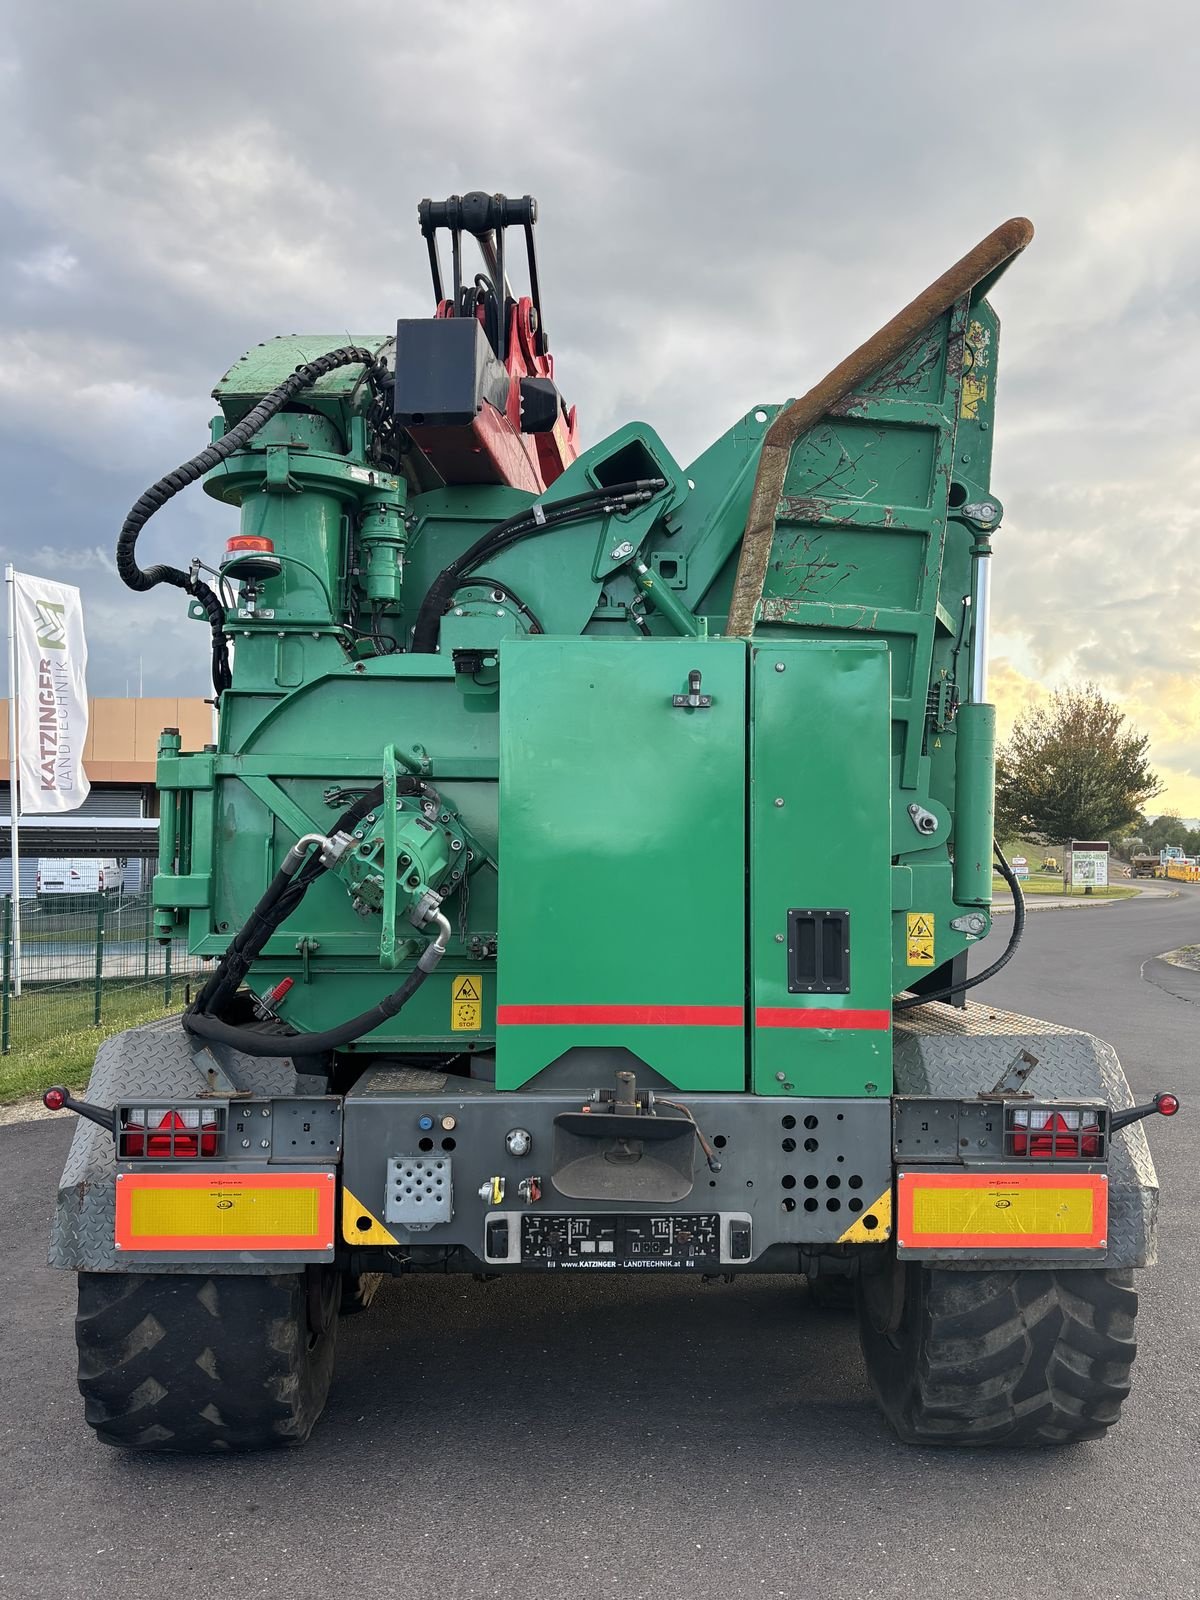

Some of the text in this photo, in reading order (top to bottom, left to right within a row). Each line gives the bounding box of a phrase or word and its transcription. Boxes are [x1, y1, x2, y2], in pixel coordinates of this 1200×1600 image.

[39, 659, 57, 791] KATZINGER
[56, 662, 73, 791] LANDTECHNIK
[560, 1260, 616, 1268] www.KATZINGER
[623, 1260, 681, 1268] LANDTECHNIK.at
